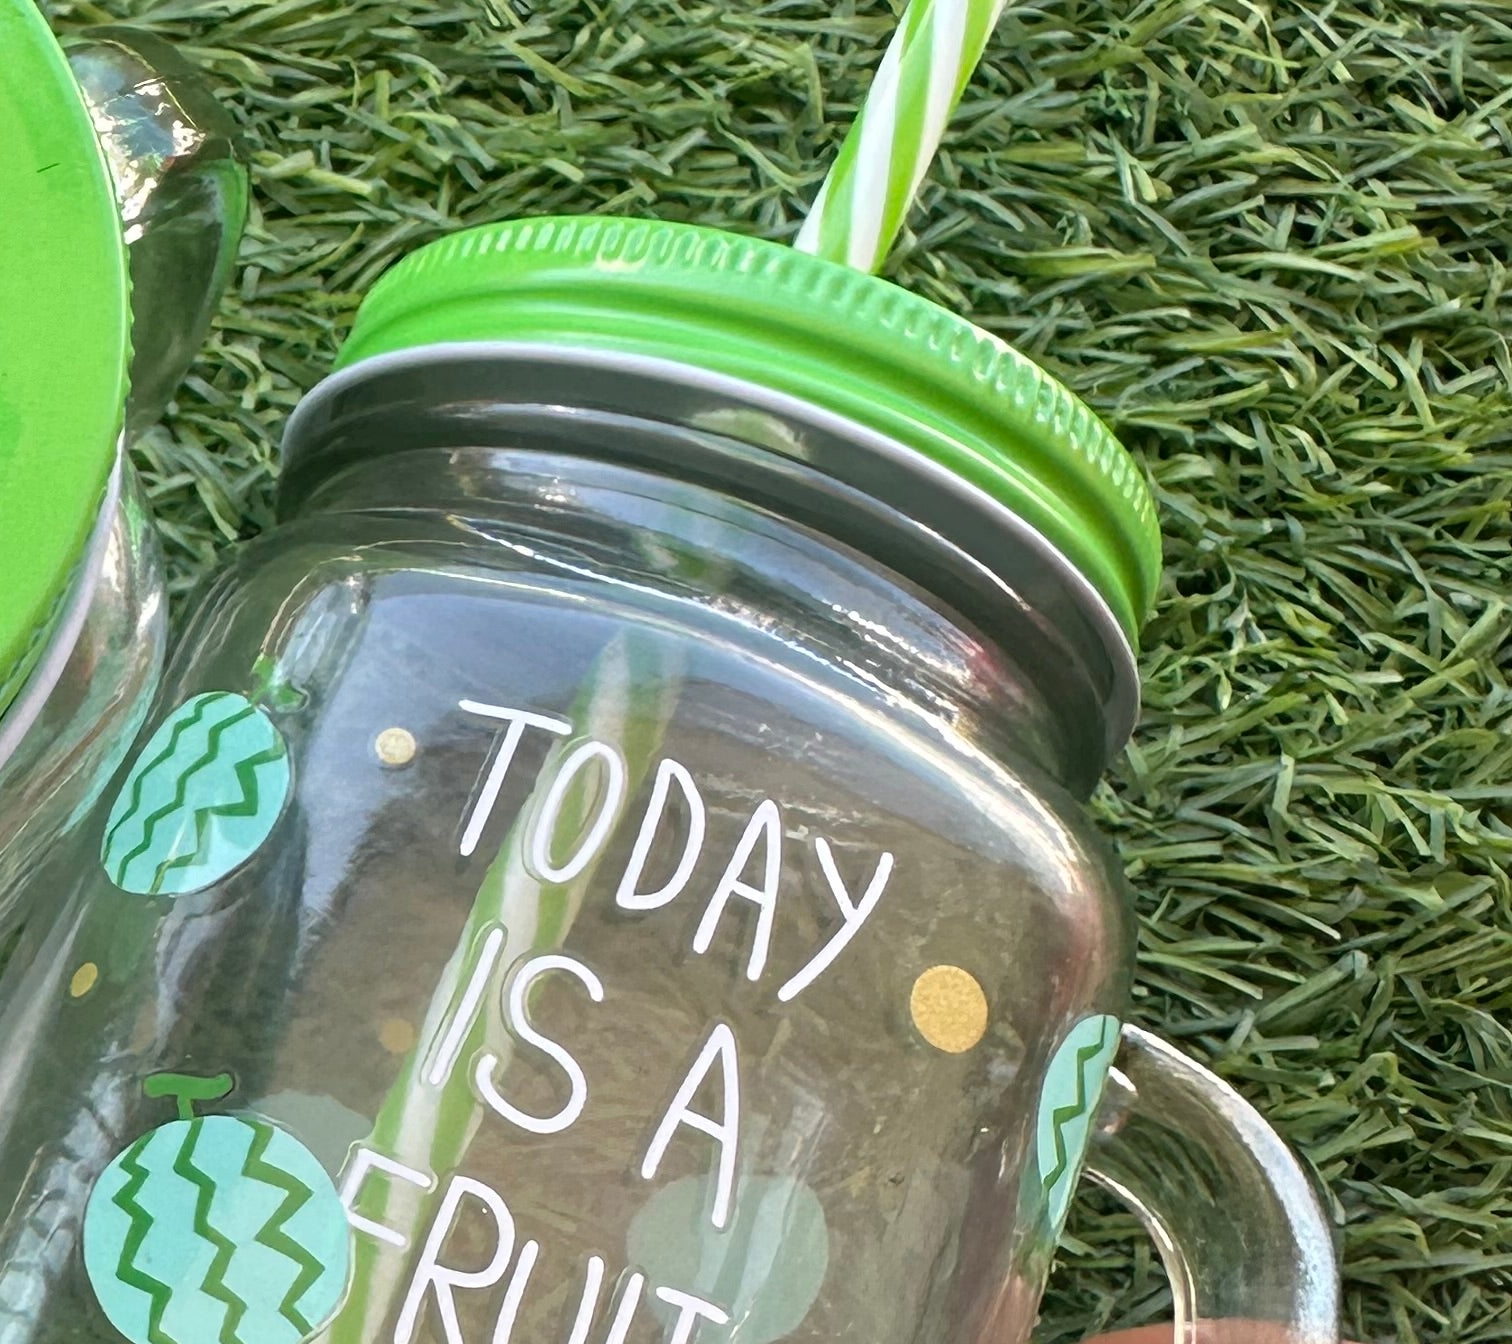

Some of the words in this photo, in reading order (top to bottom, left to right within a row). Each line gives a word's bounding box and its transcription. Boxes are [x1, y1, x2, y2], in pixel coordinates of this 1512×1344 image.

[458, 699, 893, 1002] TODAY
[428, 926, 604, 1134] IS
[641, 1023, 740, 1229] A
